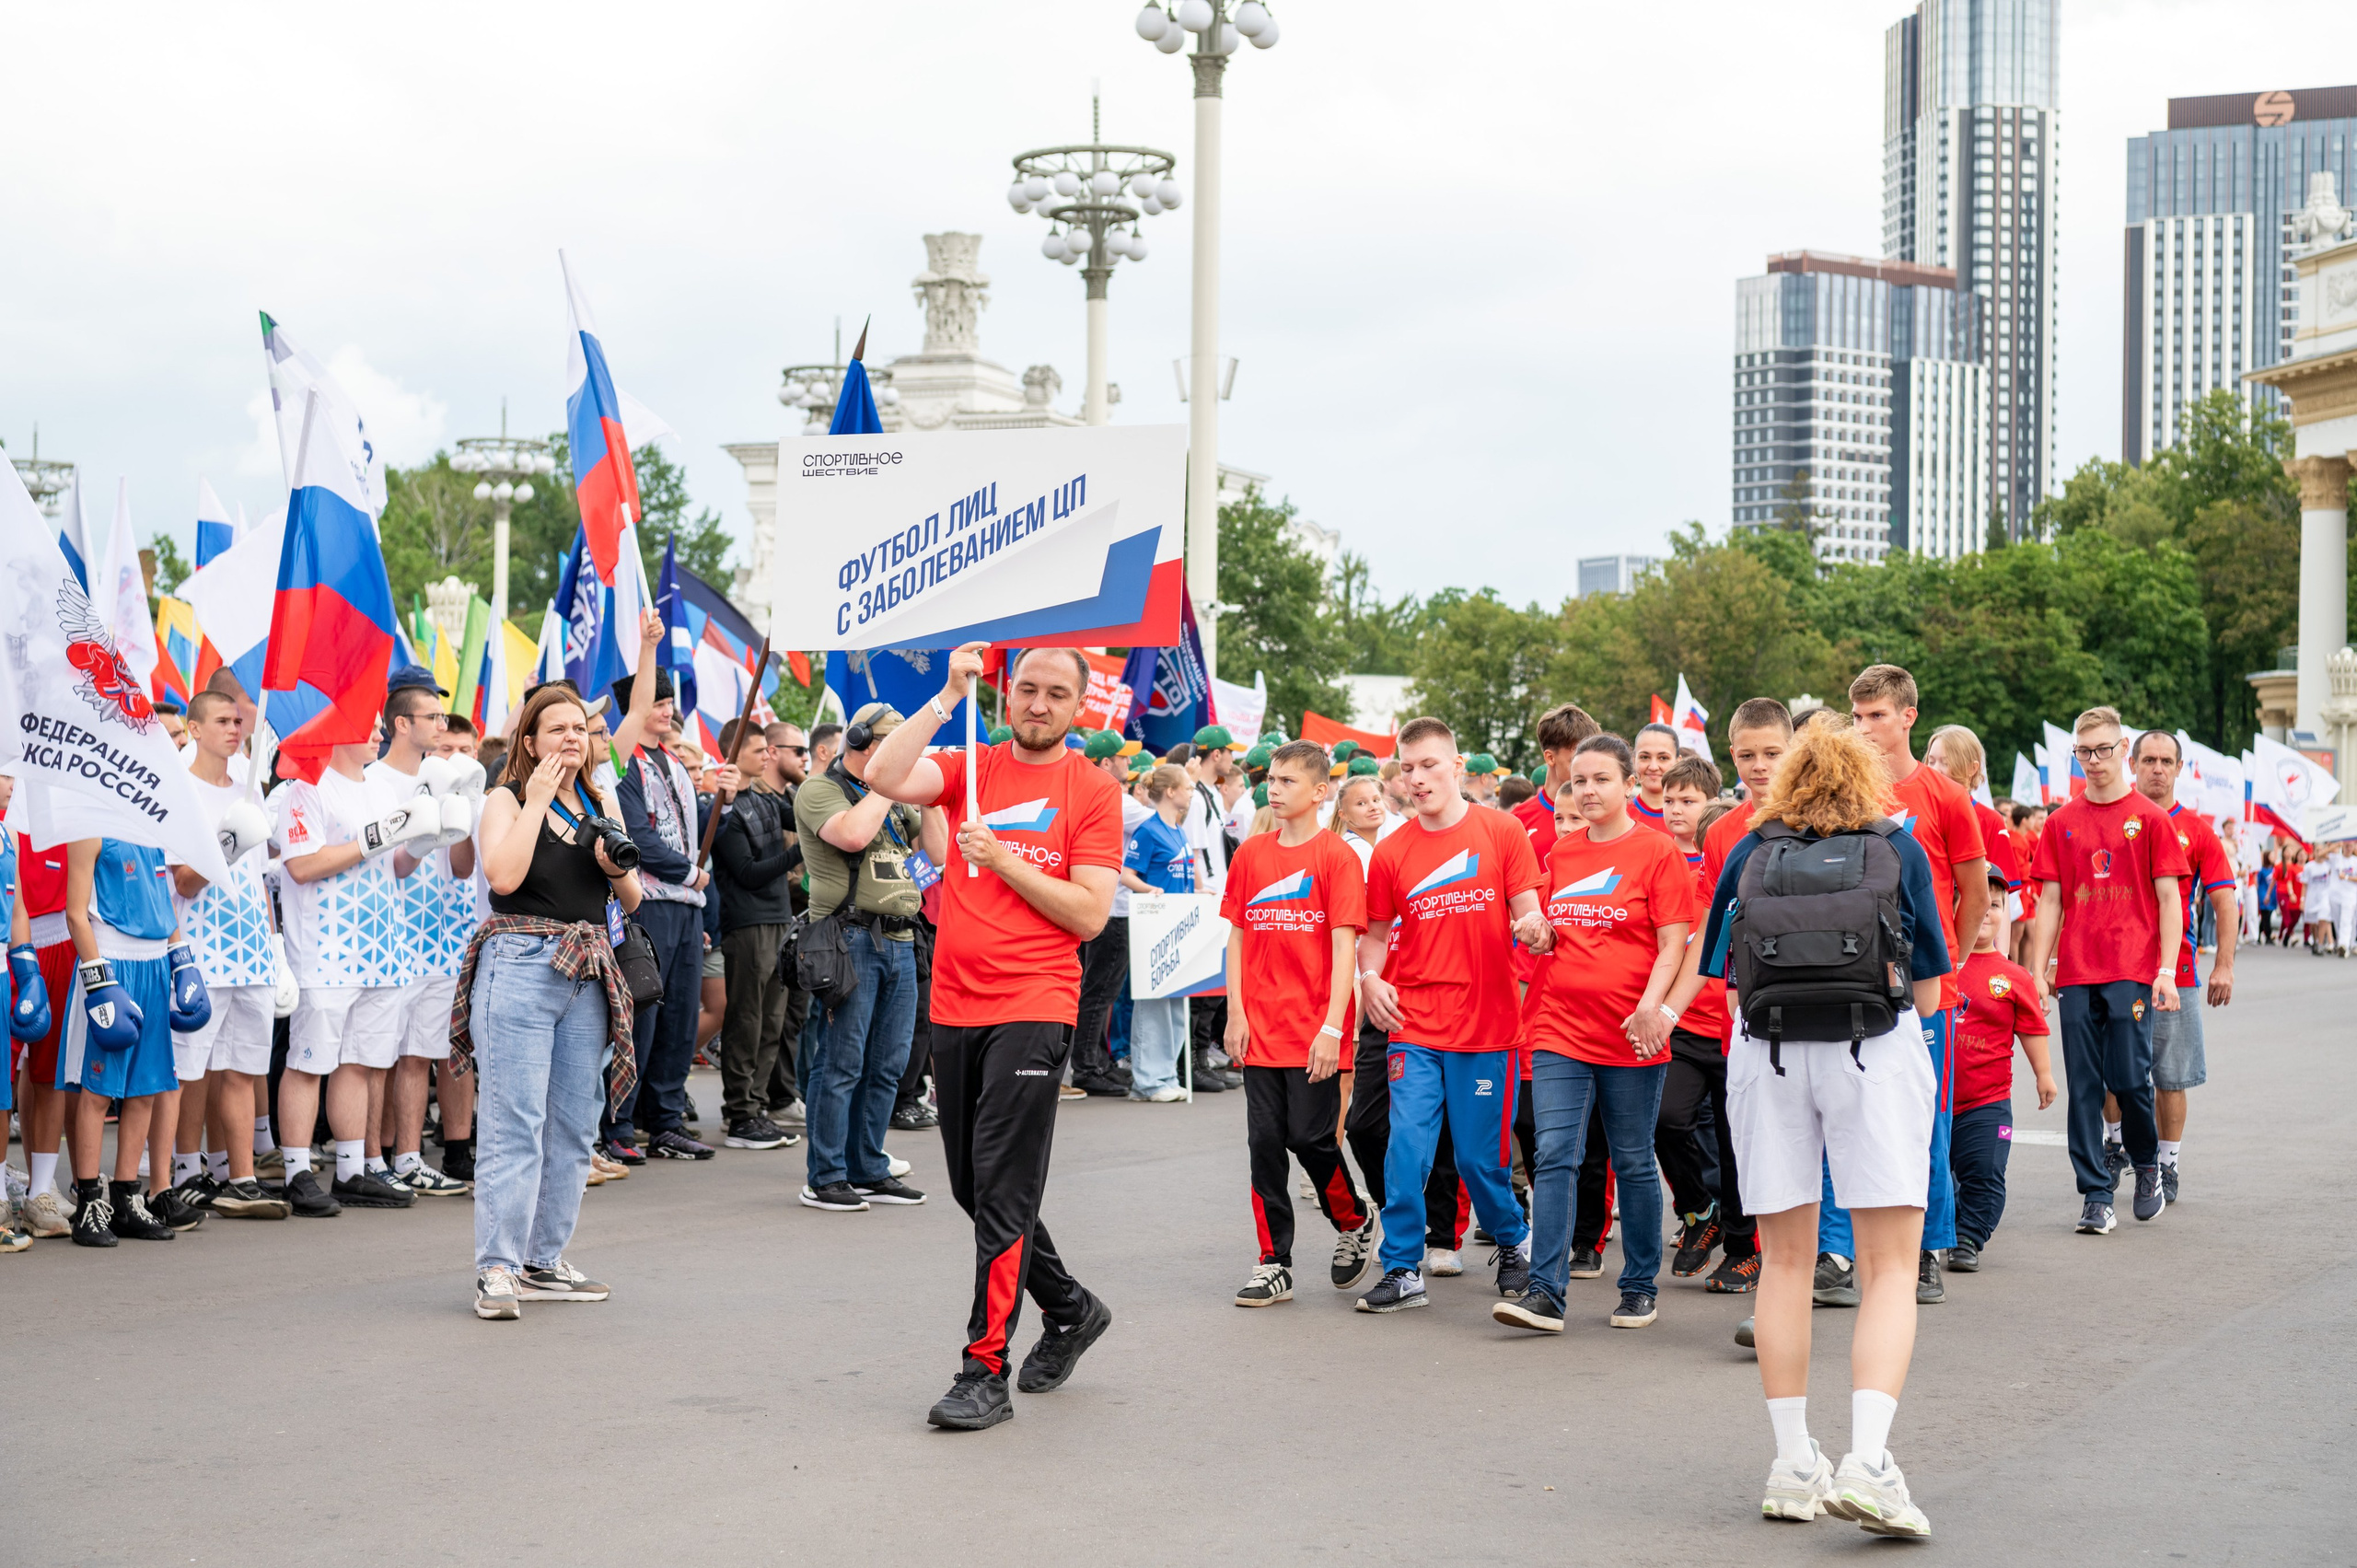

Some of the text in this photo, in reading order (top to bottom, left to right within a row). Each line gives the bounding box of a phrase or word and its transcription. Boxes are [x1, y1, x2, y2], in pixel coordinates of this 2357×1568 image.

[802, 468, 878, 477] ШЕСТВИЕ
[837, 473, 1086, 635] С ЗАБОЛЕВАНИЕМ ЦП
[838, 481, 997, 592] ФУТБОЛ ЛИЦ
[1182, 621, 1207, 694] ФЕДЕРАЦИЯ
[20, 712, 161, 790] ФЕДЕРАЦИЯ
[22, 741, 168, 823] КСА РОССИИ
[2091, 886, 2133, 895] BONUM
[1150, 904, 1200, 969] СПОРТИВНАЯ
[1253, 923, 1315, 932] ШЕСТВИЕ
[1151, 947, 1180, 992] БОРЬБА
